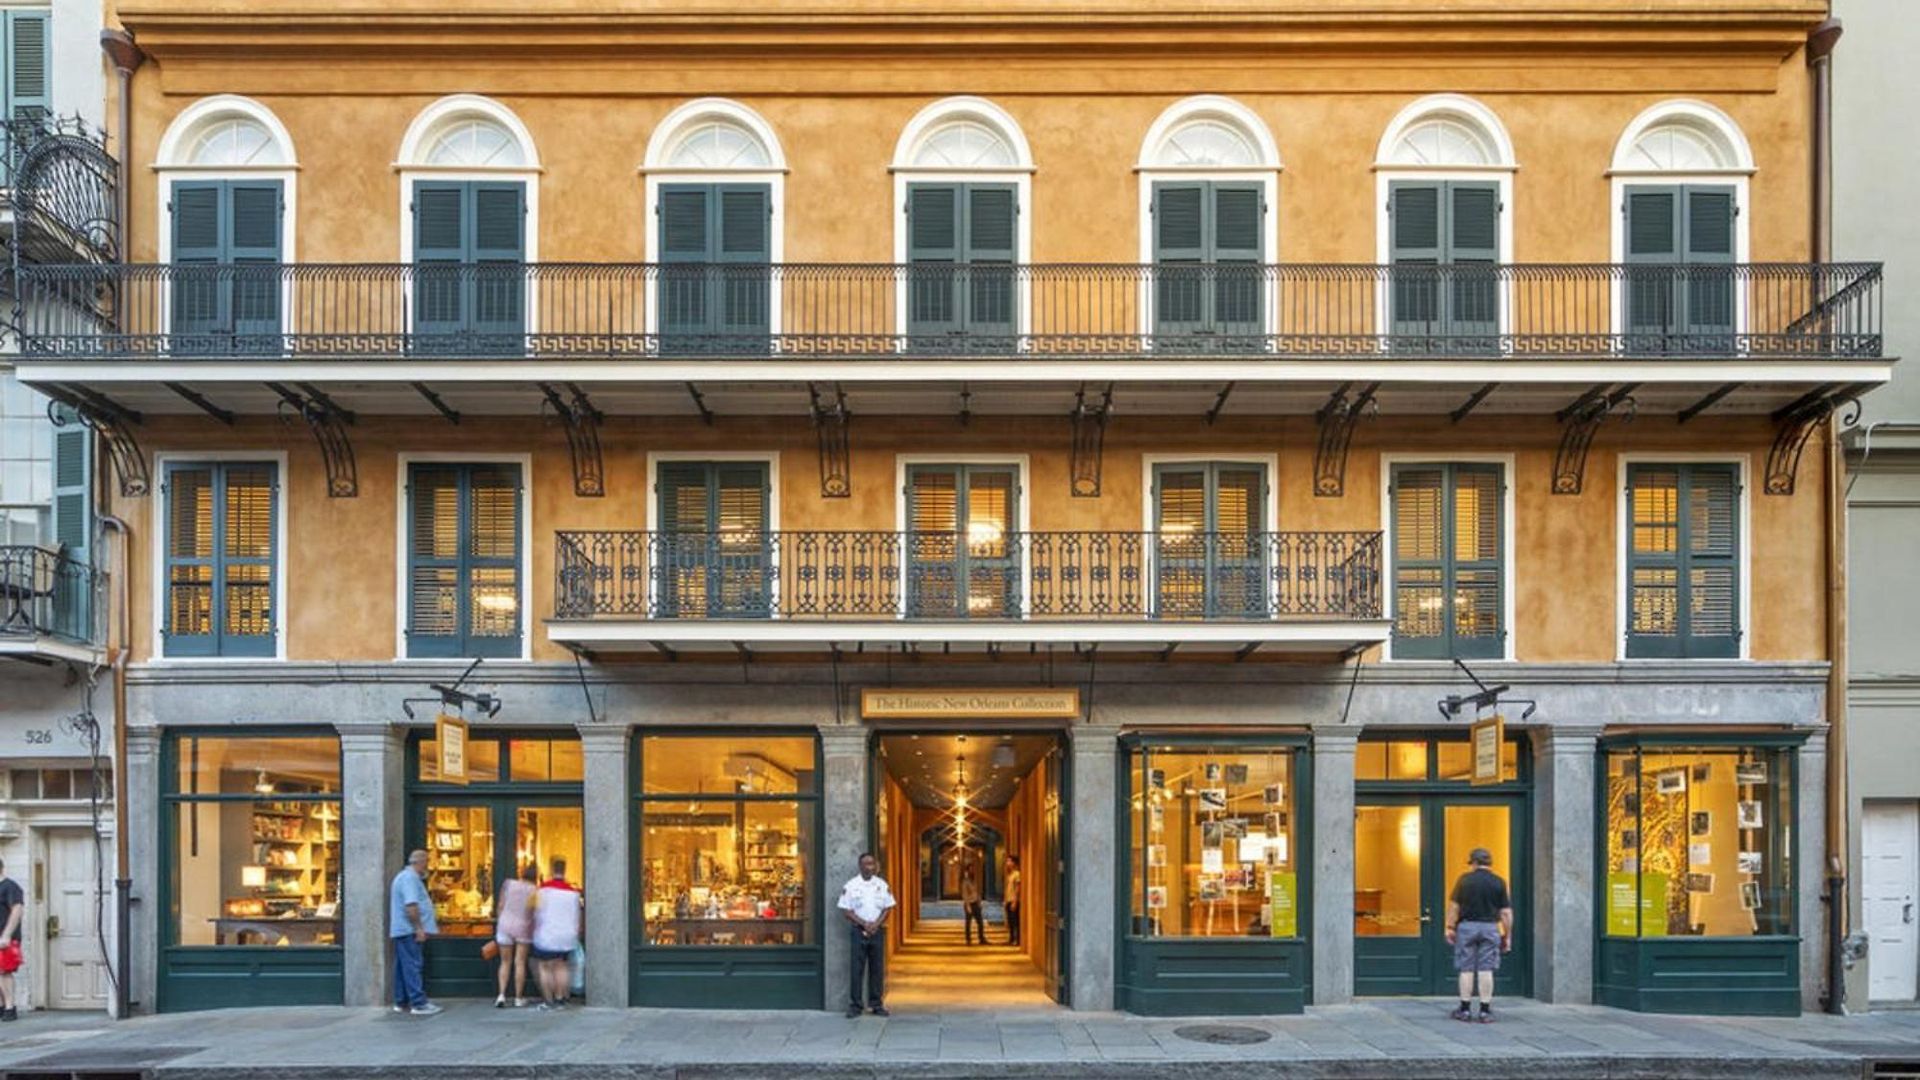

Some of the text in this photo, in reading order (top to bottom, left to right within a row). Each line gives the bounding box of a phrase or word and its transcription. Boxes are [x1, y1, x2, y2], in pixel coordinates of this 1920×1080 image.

[875, 697, 1067, 710] The Historic New Orleans Collection
[25, 729, 52, 744] 526
